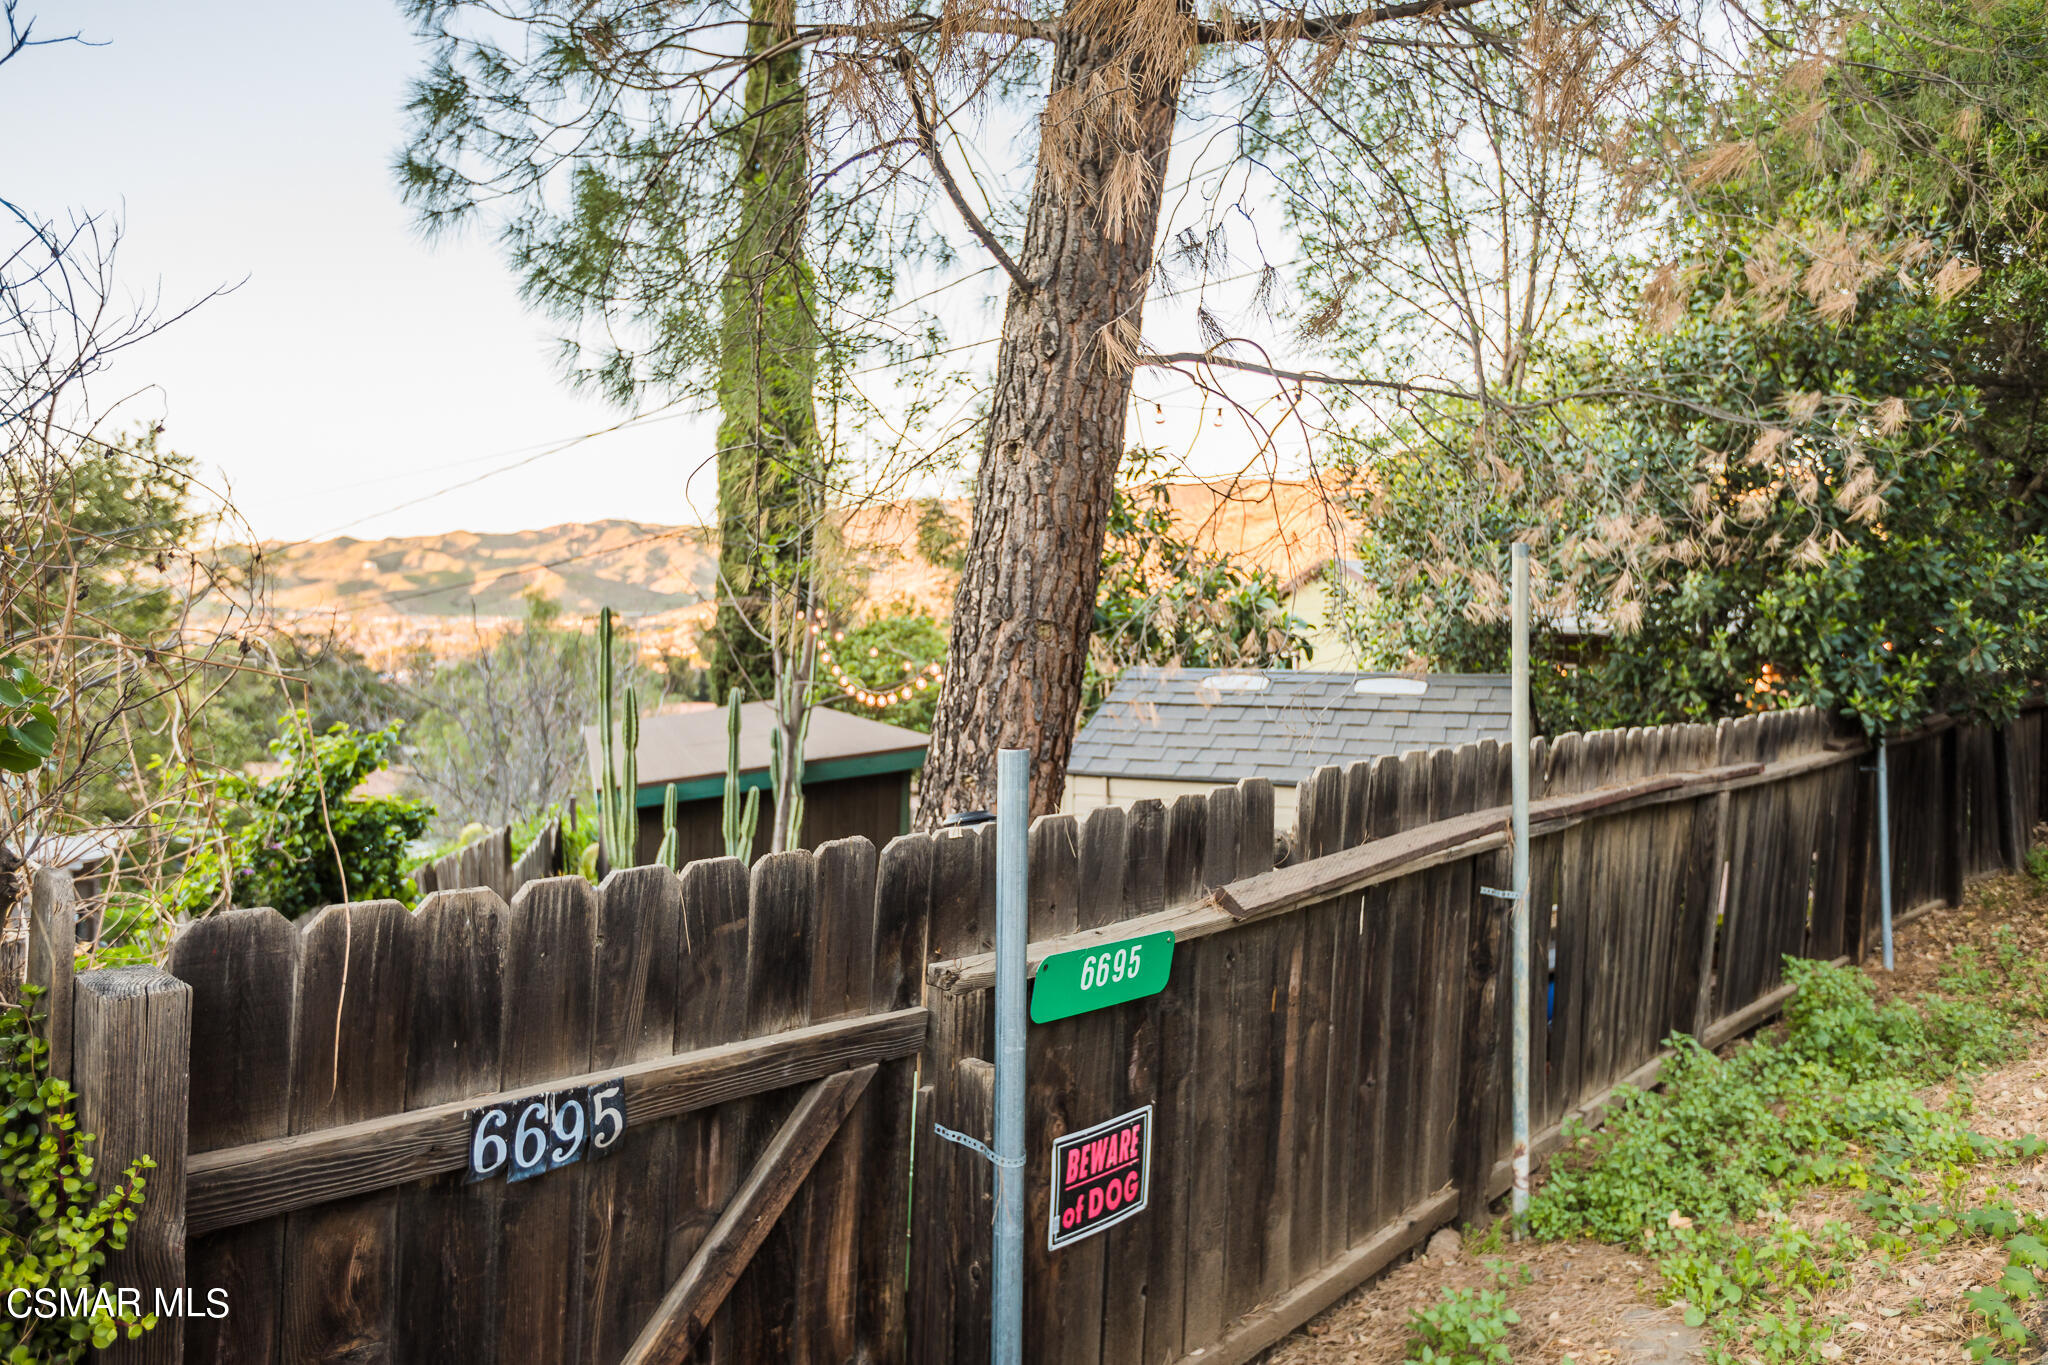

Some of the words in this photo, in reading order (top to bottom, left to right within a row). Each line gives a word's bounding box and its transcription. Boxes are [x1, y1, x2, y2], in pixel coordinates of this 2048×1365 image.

[1080, 944, 1143, 991] 6695
[473, 1086, 623, 1174] 6695
[1065, 1123, 1141, 1185] BEWARE
[1062, 1194, 1085, 1229] of
[1087, 1170, 1139, 1219] DOG
